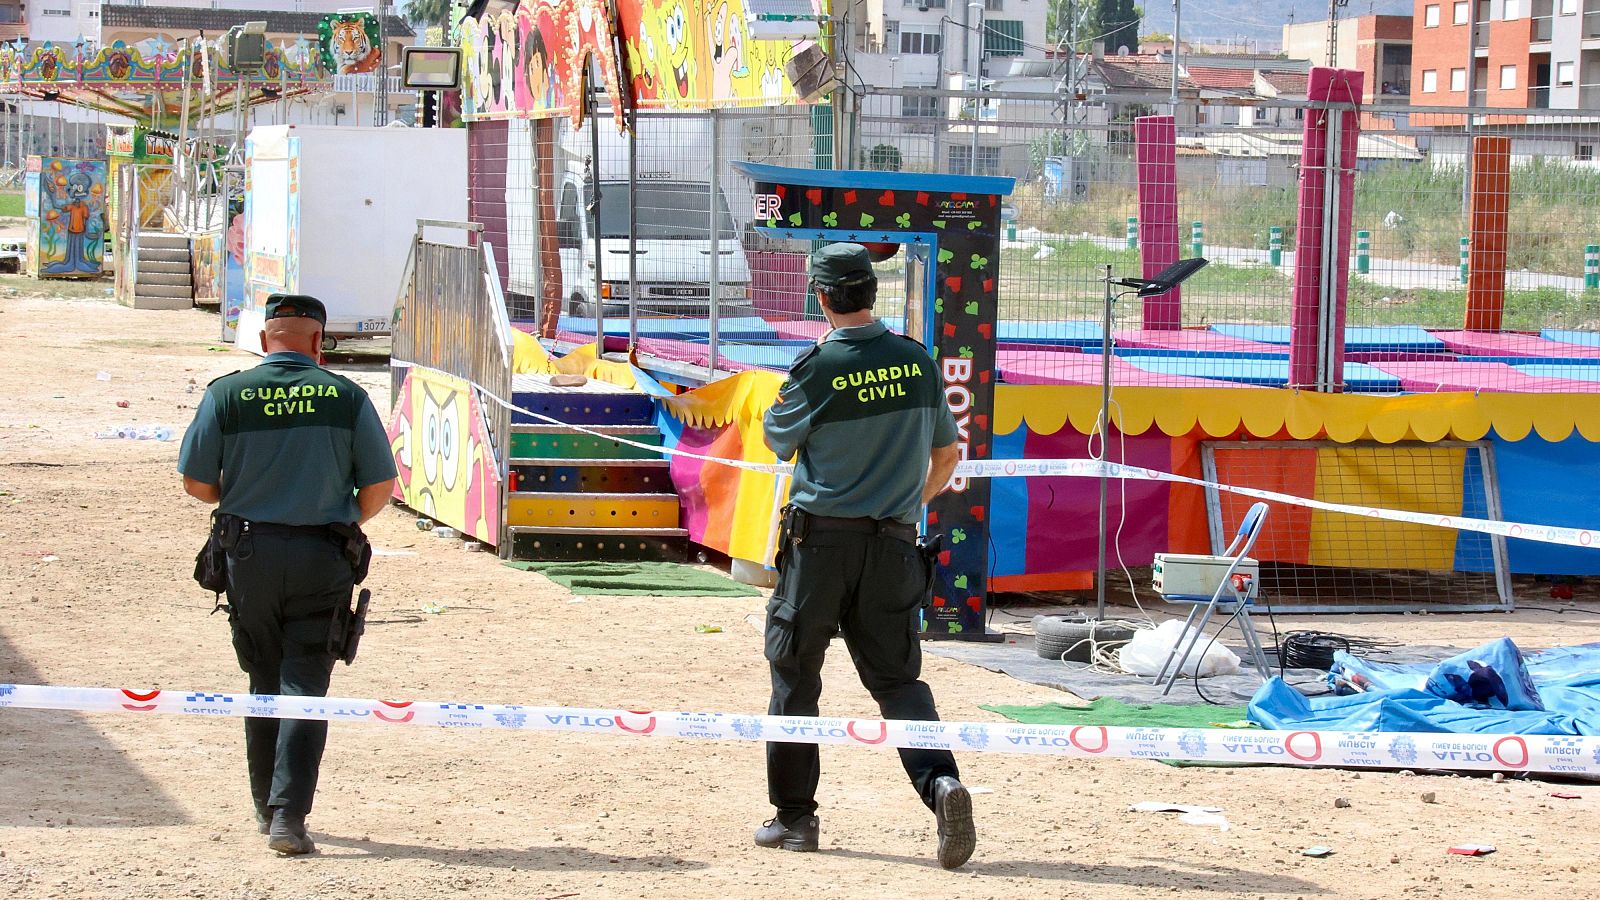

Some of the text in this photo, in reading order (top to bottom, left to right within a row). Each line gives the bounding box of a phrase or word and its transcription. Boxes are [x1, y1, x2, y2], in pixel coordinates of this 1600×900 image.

[754, 194, 783, 220] ER
[364, 322, 386, 330] 3077
[832, 363, 922, 390] GUARDIA
[240, 384, 339, 401] GUARDIA
[858, 383, 906, 402] CIVIL
[264, 400, 315, 416] CIVIL
